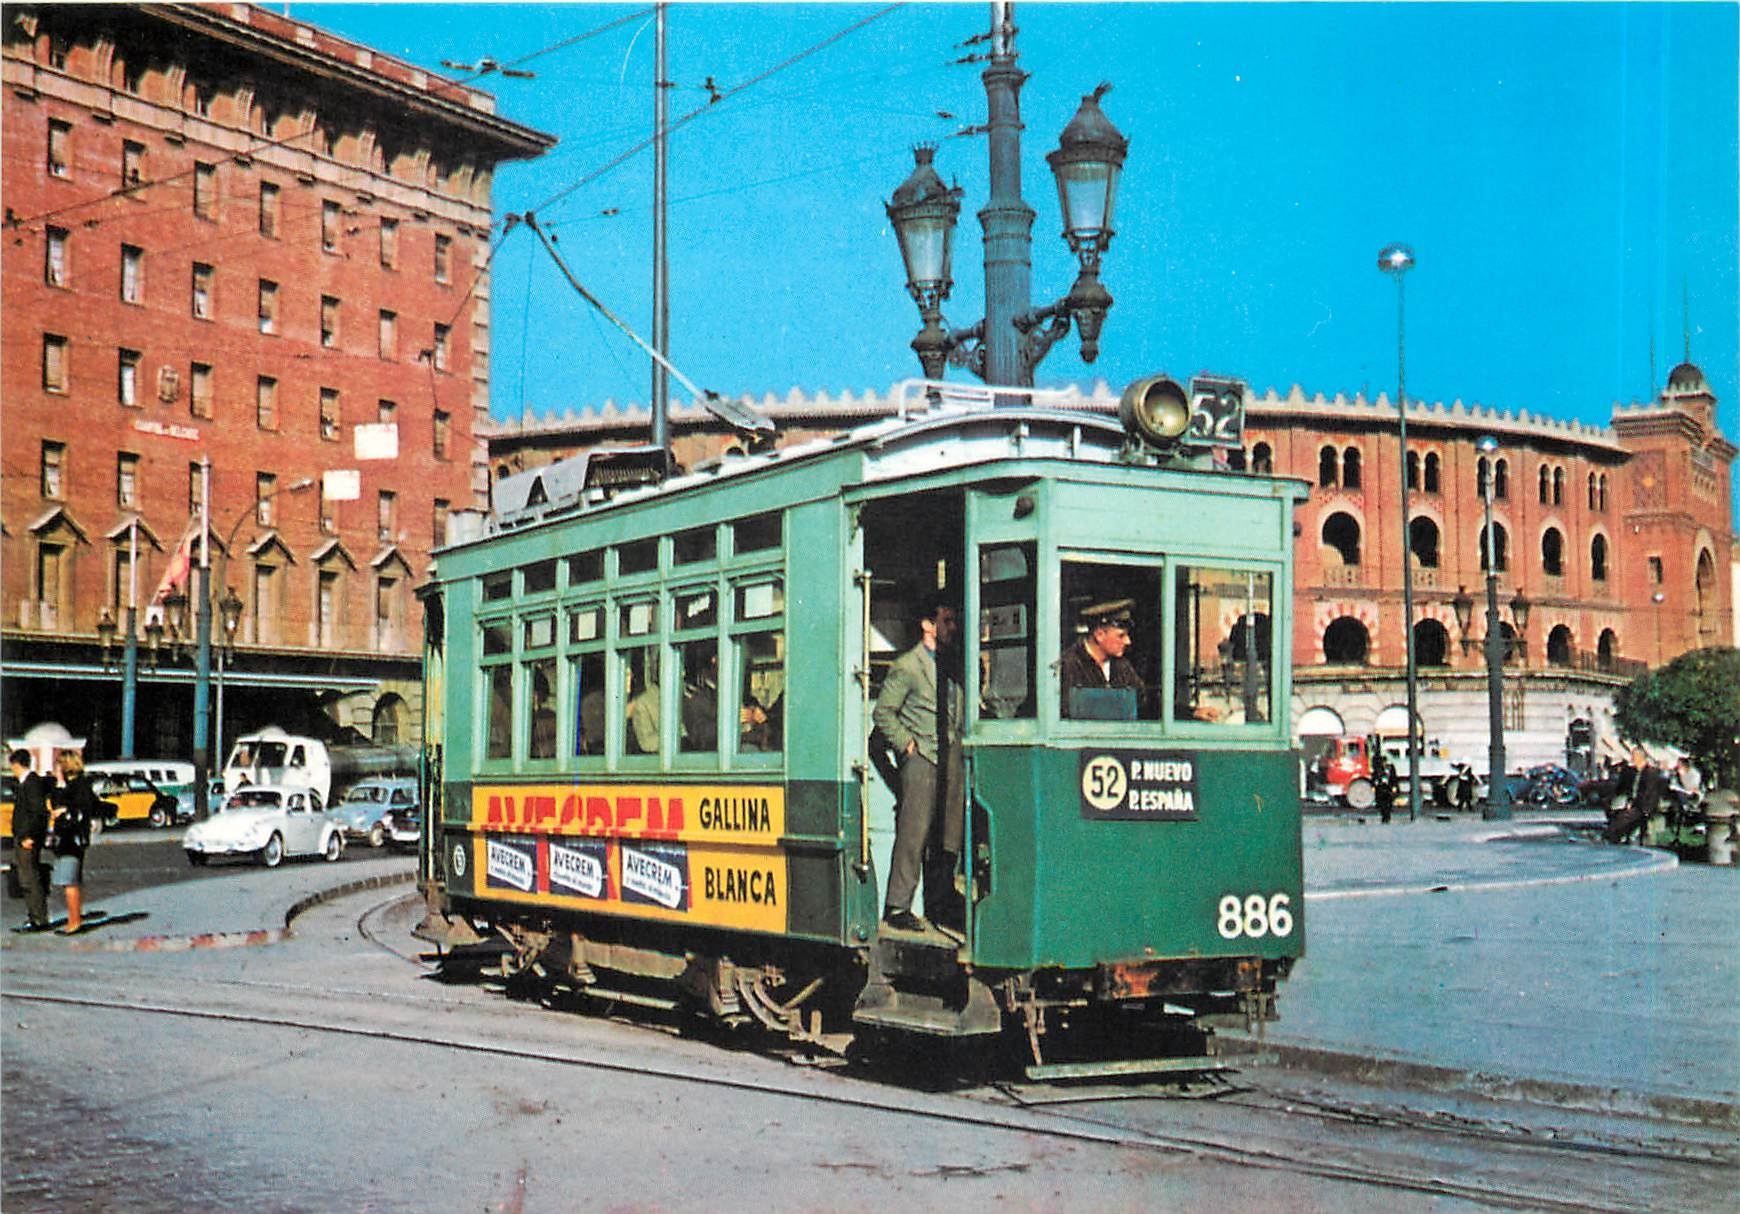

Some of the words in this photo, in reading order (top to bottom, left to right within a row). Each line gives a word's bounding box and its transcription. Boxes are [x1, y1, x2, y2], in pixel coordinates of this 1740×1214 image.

[1192, 393, 1240, 439] 52
[1091, 765, 1119, 798] 52
[700, 797, 771, 832] GALLINA
[491, 846, 526, 873] AVECREM
[555, 850, 594, 879] AVECREM
[627, 854, 672, 888] AVECREM
[705, 866, 777, 906] BLANCA
[1217, 893, 1294, 938] 886
